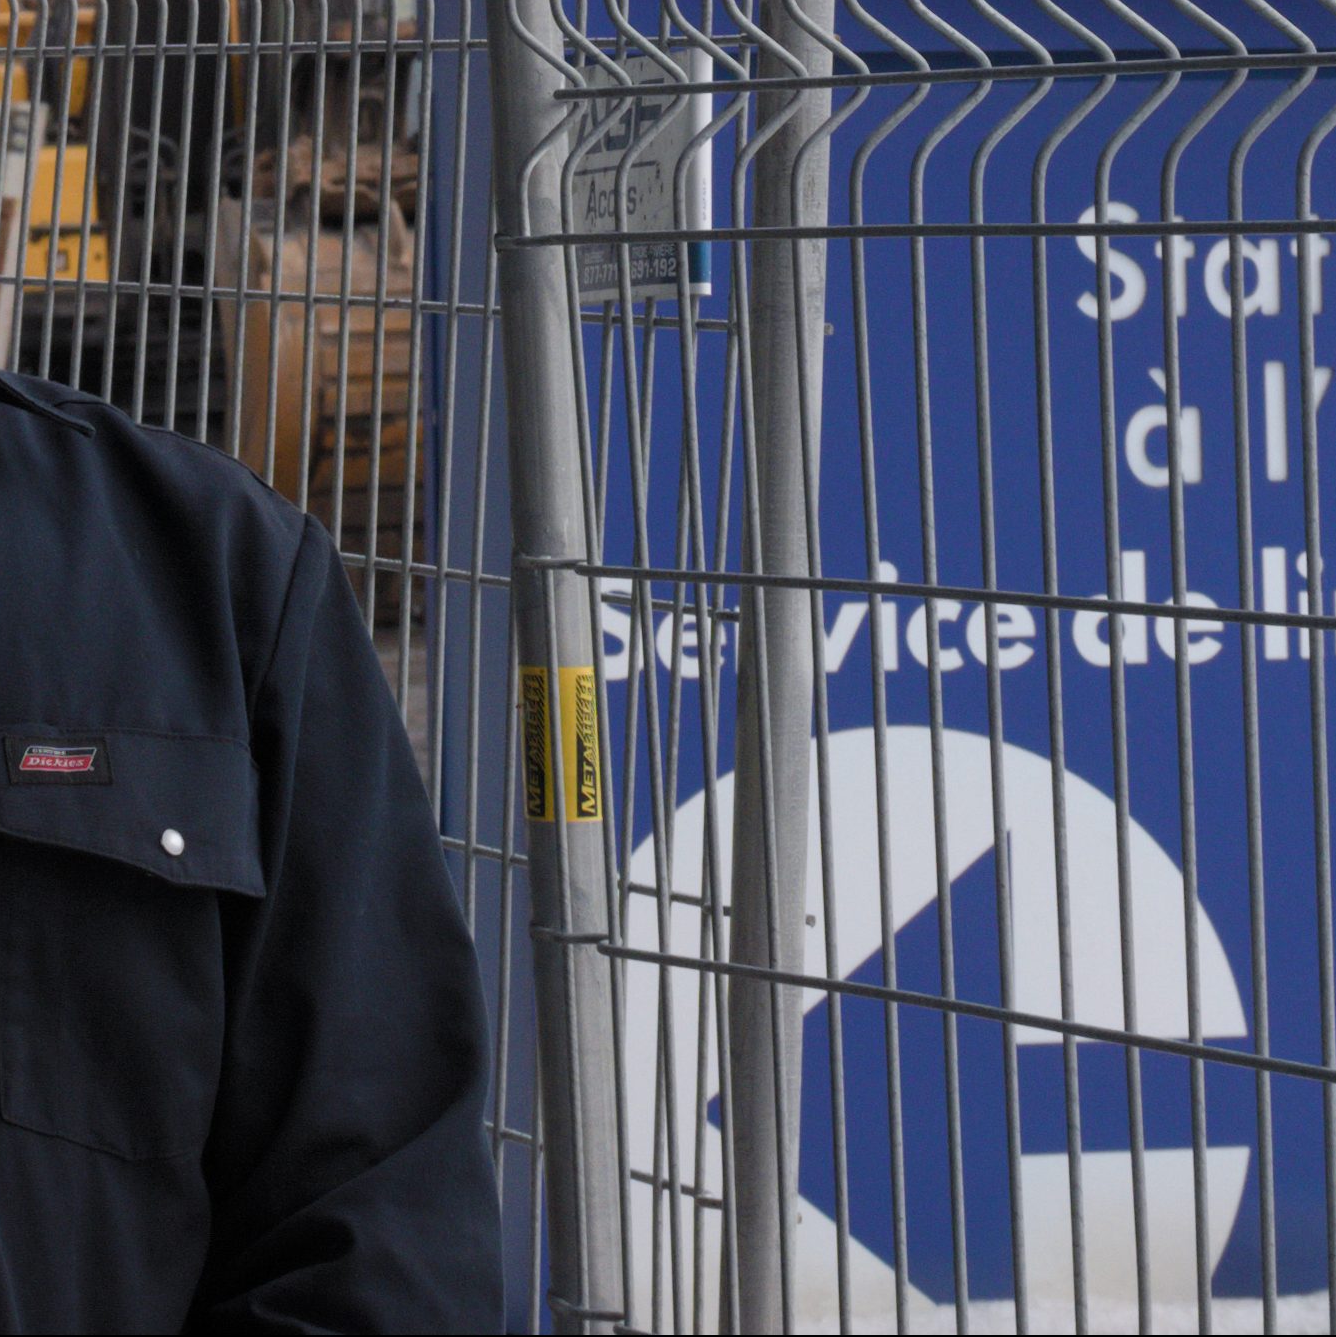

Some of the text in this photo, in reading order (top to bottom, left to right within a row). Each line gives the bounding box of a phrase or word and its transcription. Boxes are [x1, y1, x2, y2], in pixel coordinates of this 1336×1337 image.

[584, 179, 638, 220] Accs
[1124, 365, 1202, 488] à
[597, 560, 1036, 682] Sevice
[1071, 549, 1225, 666] de
[28, 757, 84, 767] Dickies
